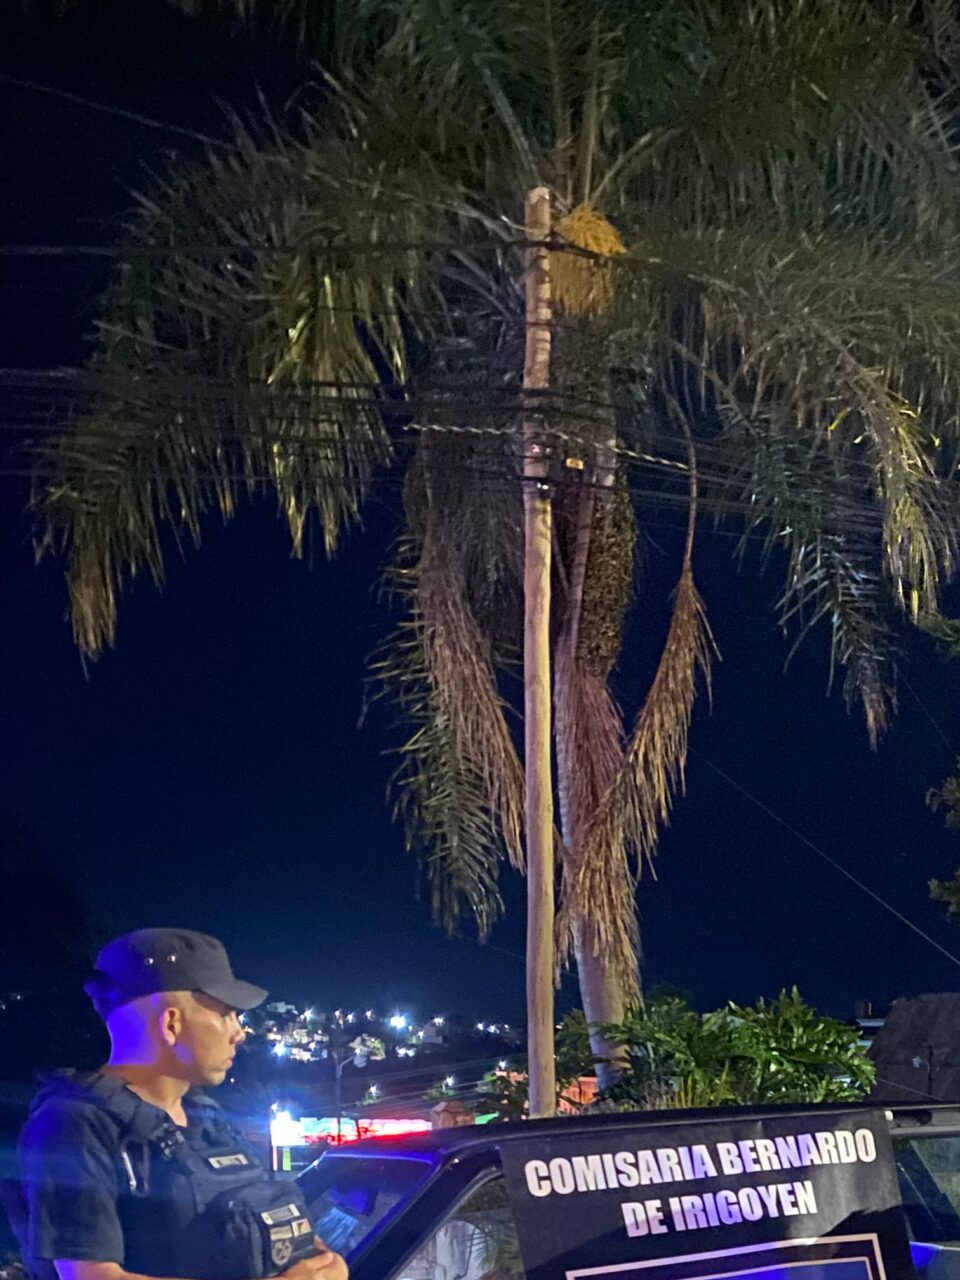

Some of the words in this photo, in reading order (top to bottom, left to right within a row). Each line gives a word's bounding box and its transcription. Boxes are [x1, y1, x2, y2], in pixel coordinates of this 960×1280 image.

[525, 1144, 717, 1197] COMISARIA
[716, 1128, 877, 1175] BERNARDO
[621, 1199, 668, 1237] DE
[669, 1180, 818, 1231] IRIGOYEN
